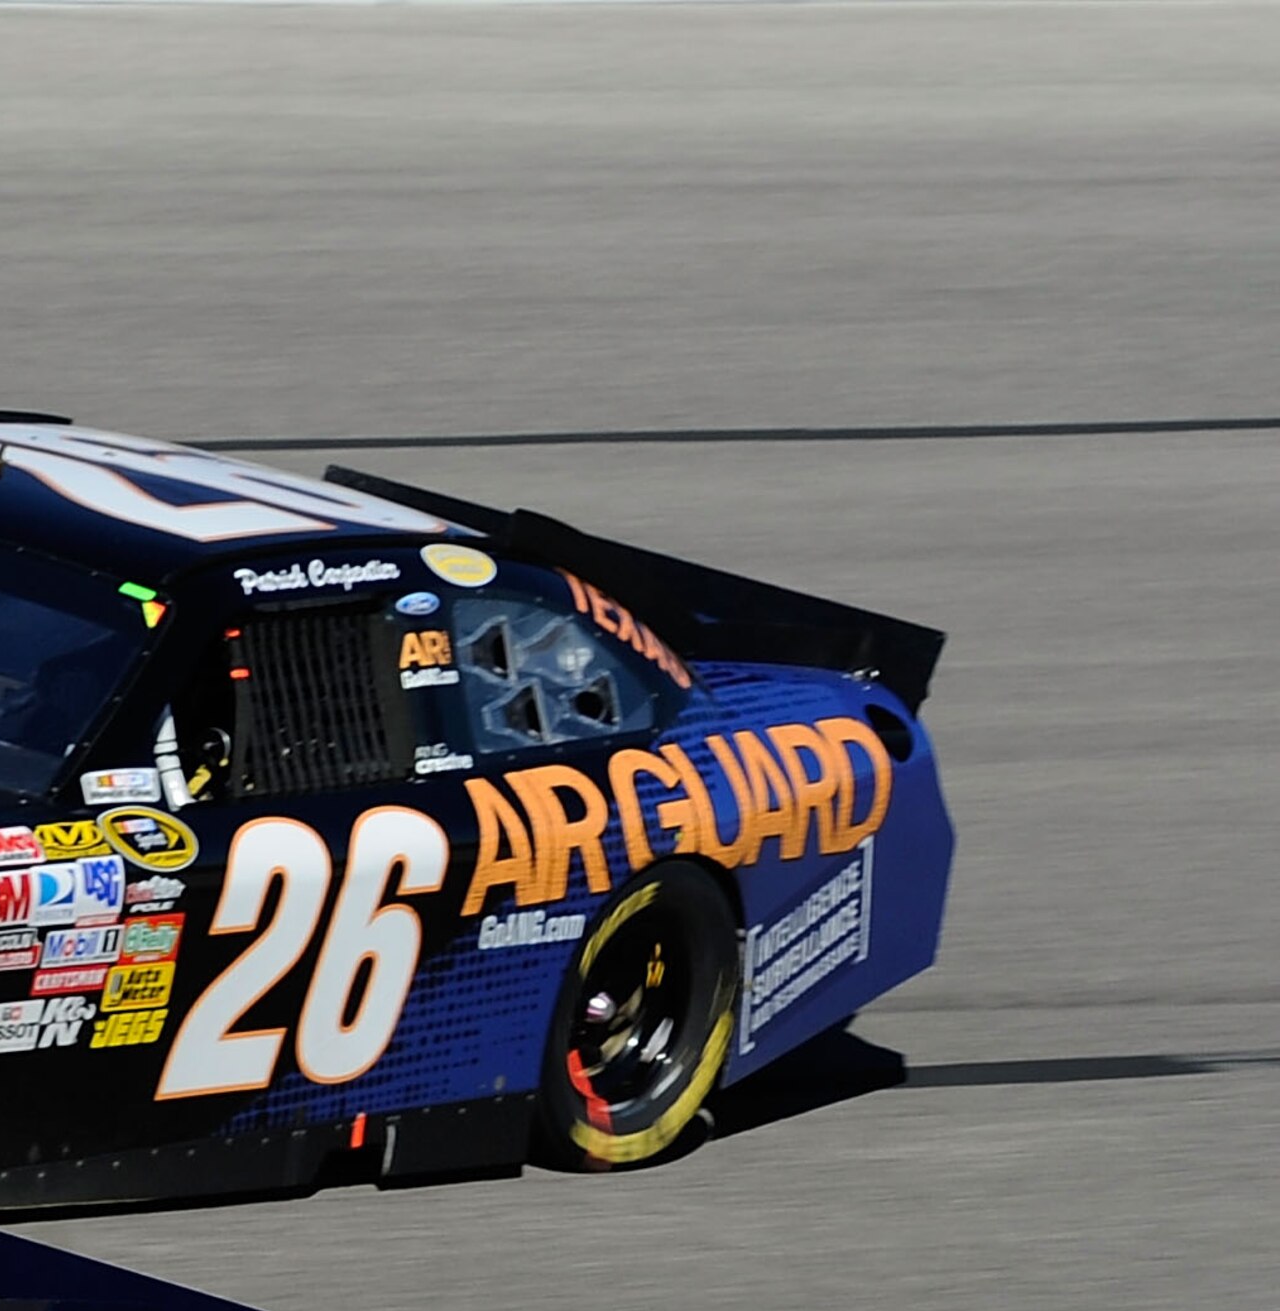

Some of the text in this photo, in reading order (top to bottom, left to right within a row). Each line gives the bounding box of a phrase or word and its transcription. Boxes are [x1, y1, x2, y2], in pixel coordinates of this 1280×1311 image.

[460, 717, 893, 916] AIR GUARD
[47, 930, 98, 959] Mobil
[82, 860, 119, 907] USG
[154, 805, 450, 1101] 26
